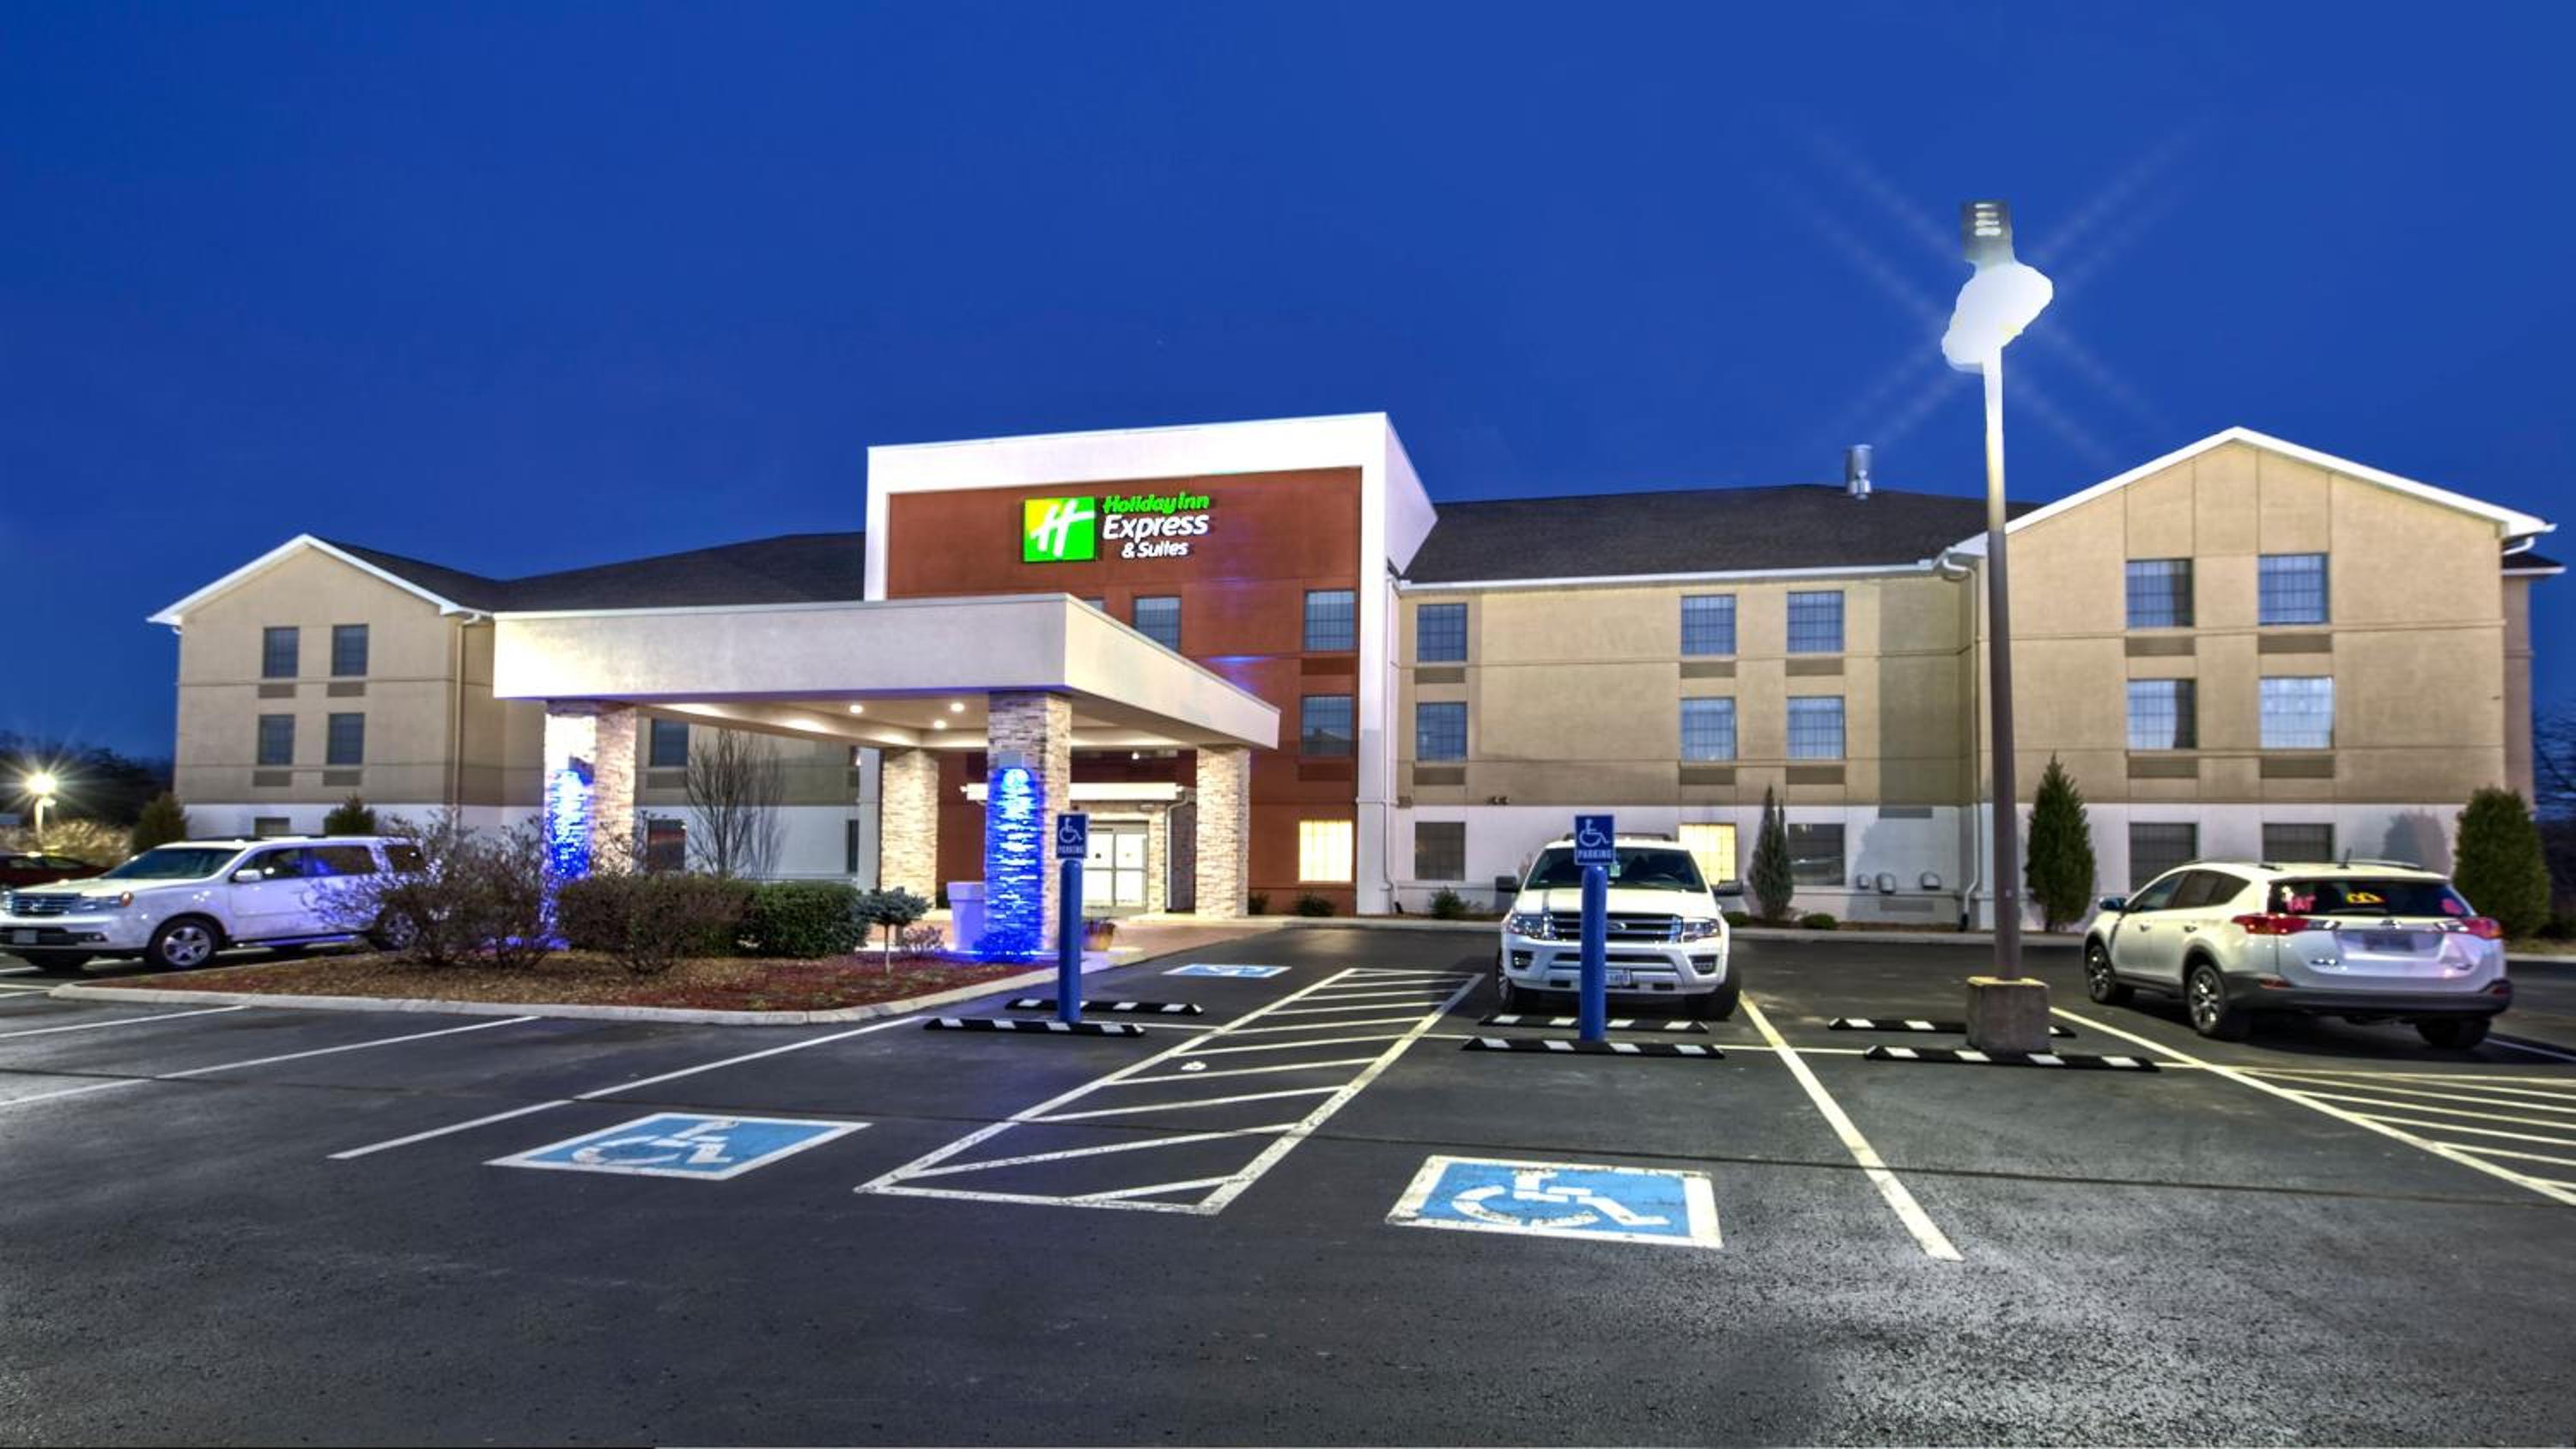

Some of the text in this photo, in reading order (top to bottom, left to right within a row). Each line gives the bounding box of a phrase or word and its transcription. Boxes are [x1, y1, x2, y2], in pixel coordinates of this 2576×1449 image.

[1103, 492, 1209, 515] Holiday Inn
[1103, 514, 1210, 543] Express
[1121, 541, 1188, 558] & Suites
[1578, 850, 1612, 858] PARKING
